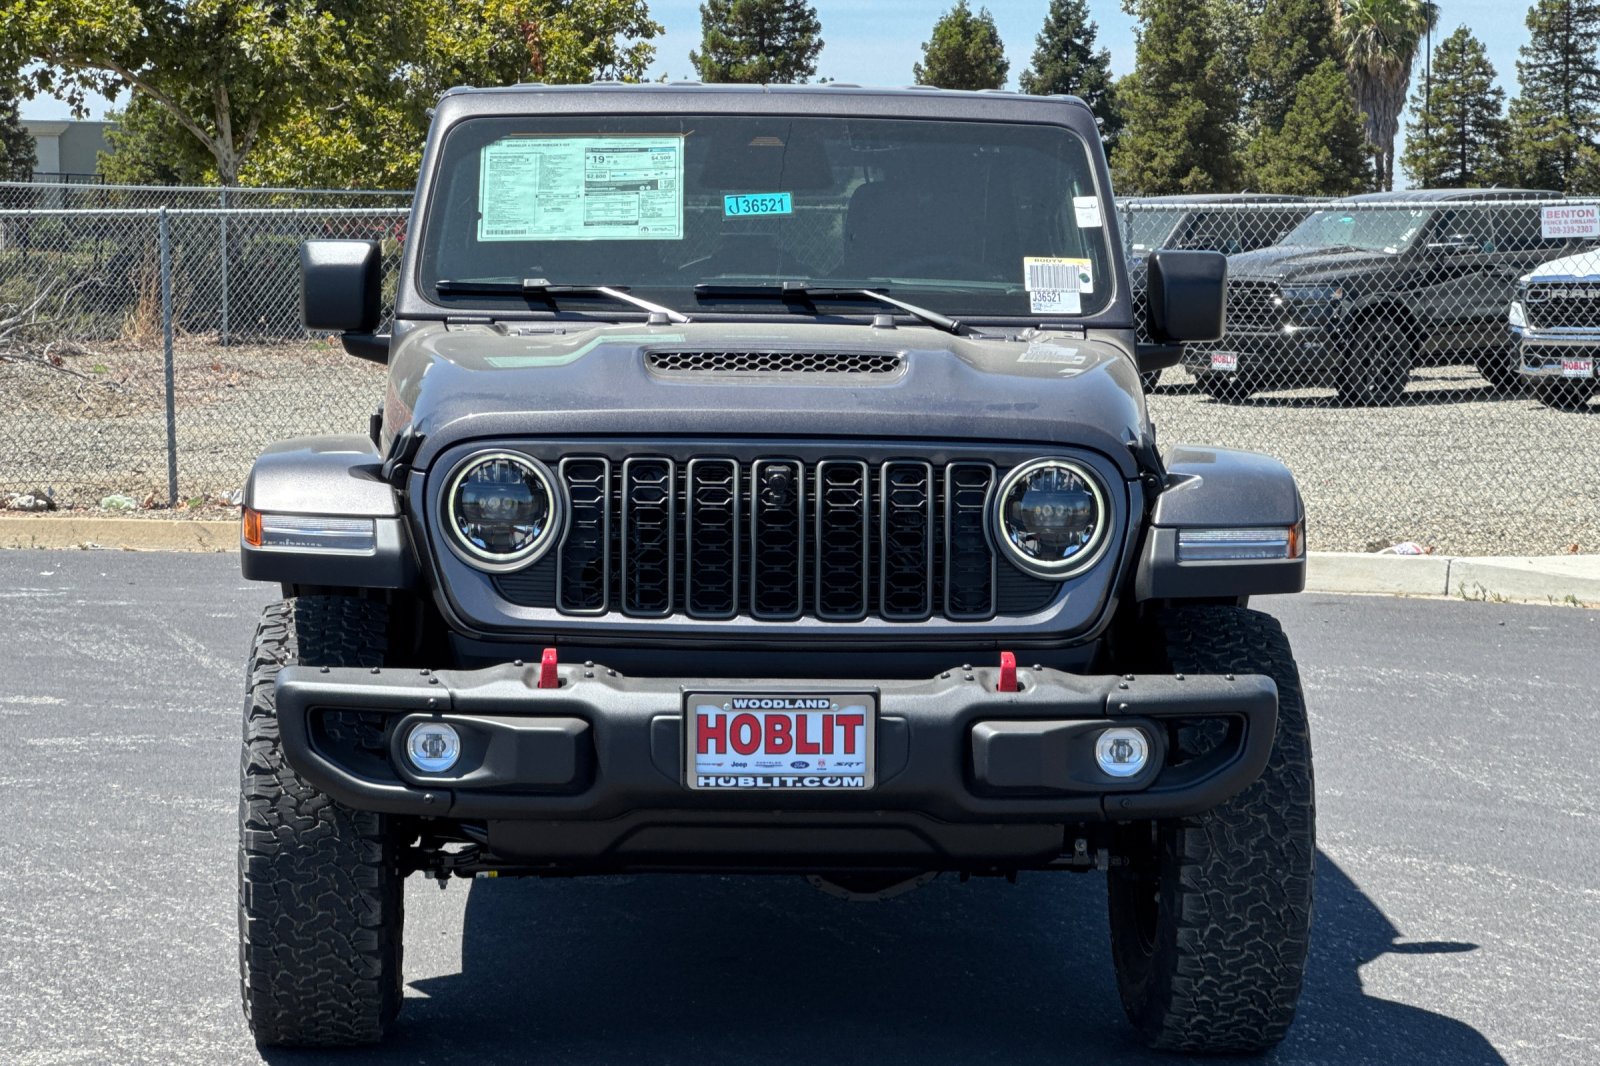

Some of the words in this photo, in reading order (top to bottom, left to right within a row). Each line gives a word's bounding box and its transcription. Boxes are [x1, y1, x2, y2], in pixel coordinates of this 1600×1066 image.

[592, 155, 605, 164] 19
[726, 195, 784, 215] J36521
[1546, 209, 1595, 219] BENTON
[1570, 217, 1598, 225] DRILLING
[1032, 292, 1061, 303] J36521
[1562, 361, 1591, 370] HOBLIT
[733, 699, 830, 709] WOODLAND
[696, 713, 864, 756] HOBLIT
[698, 776, 864, 787] HOBLIT.COM
